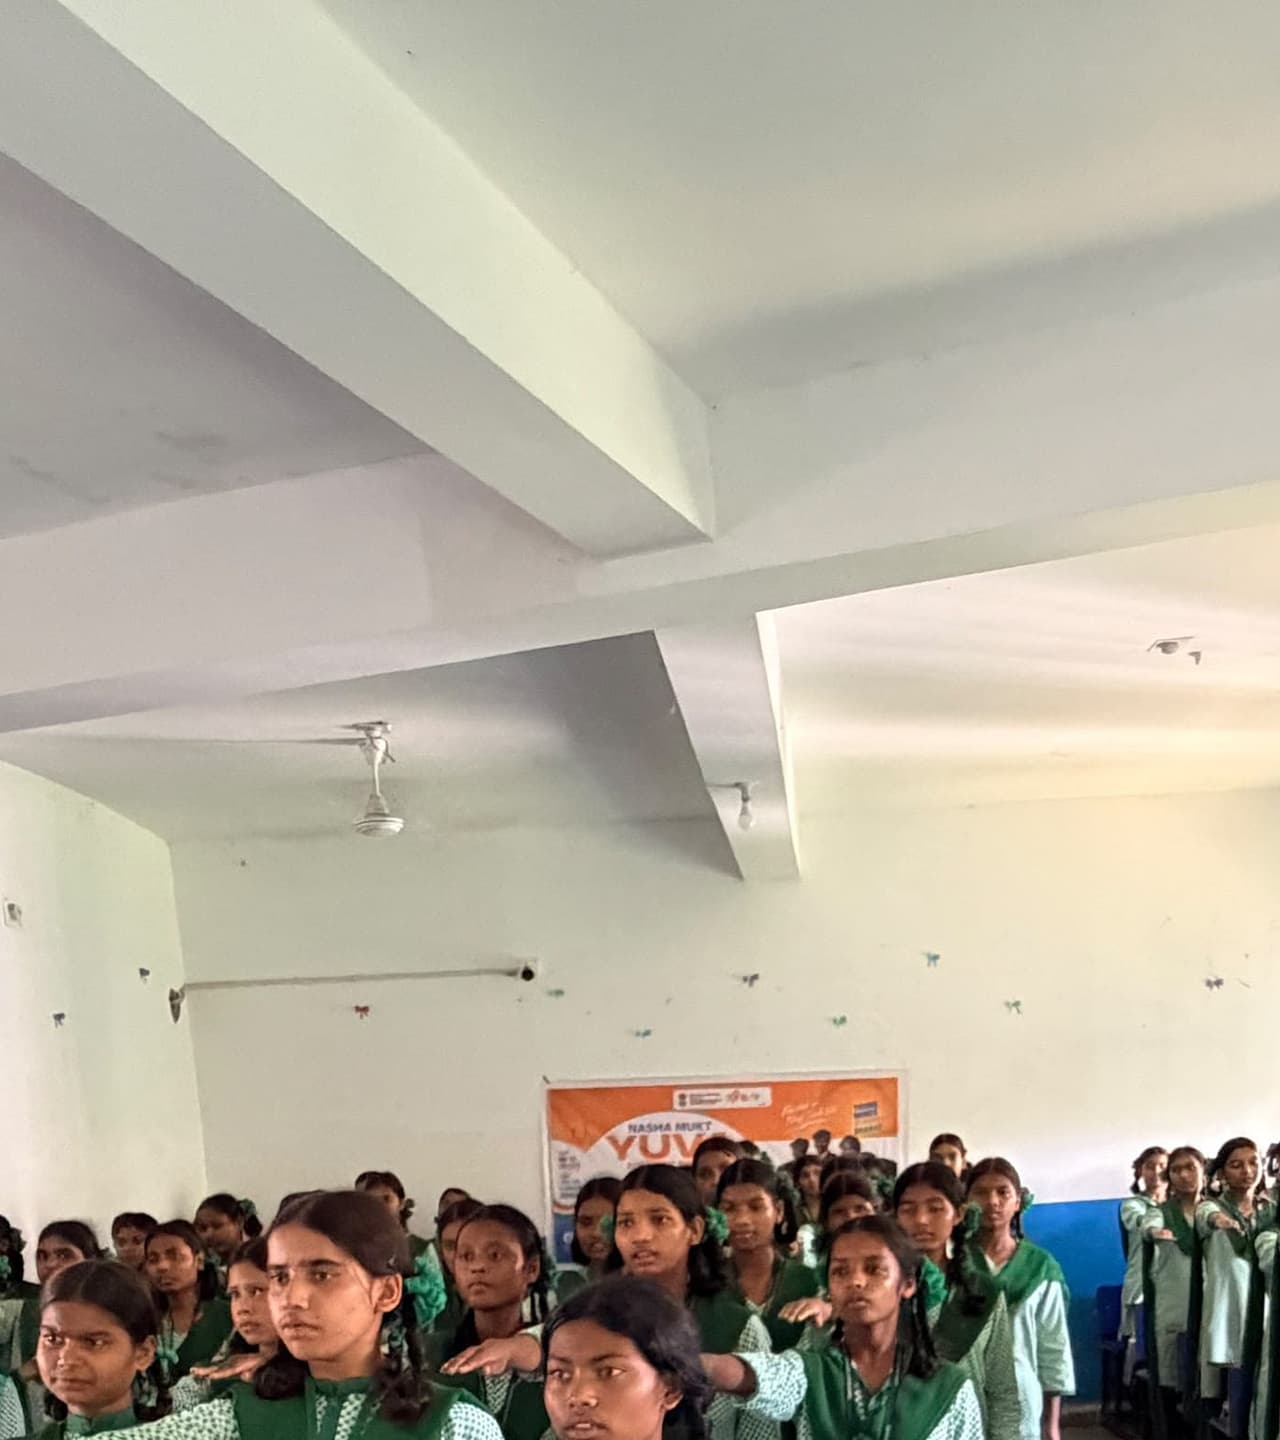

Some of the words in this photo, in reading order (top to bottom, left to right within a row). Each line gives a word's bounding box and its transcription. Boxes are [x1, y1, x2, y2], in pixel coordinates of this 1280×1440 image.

[628, 1122, 672, 1133] NASHA
[675, 1121, 713, 1132] MUKT
[606, 1132, 726, 1161] YUV
